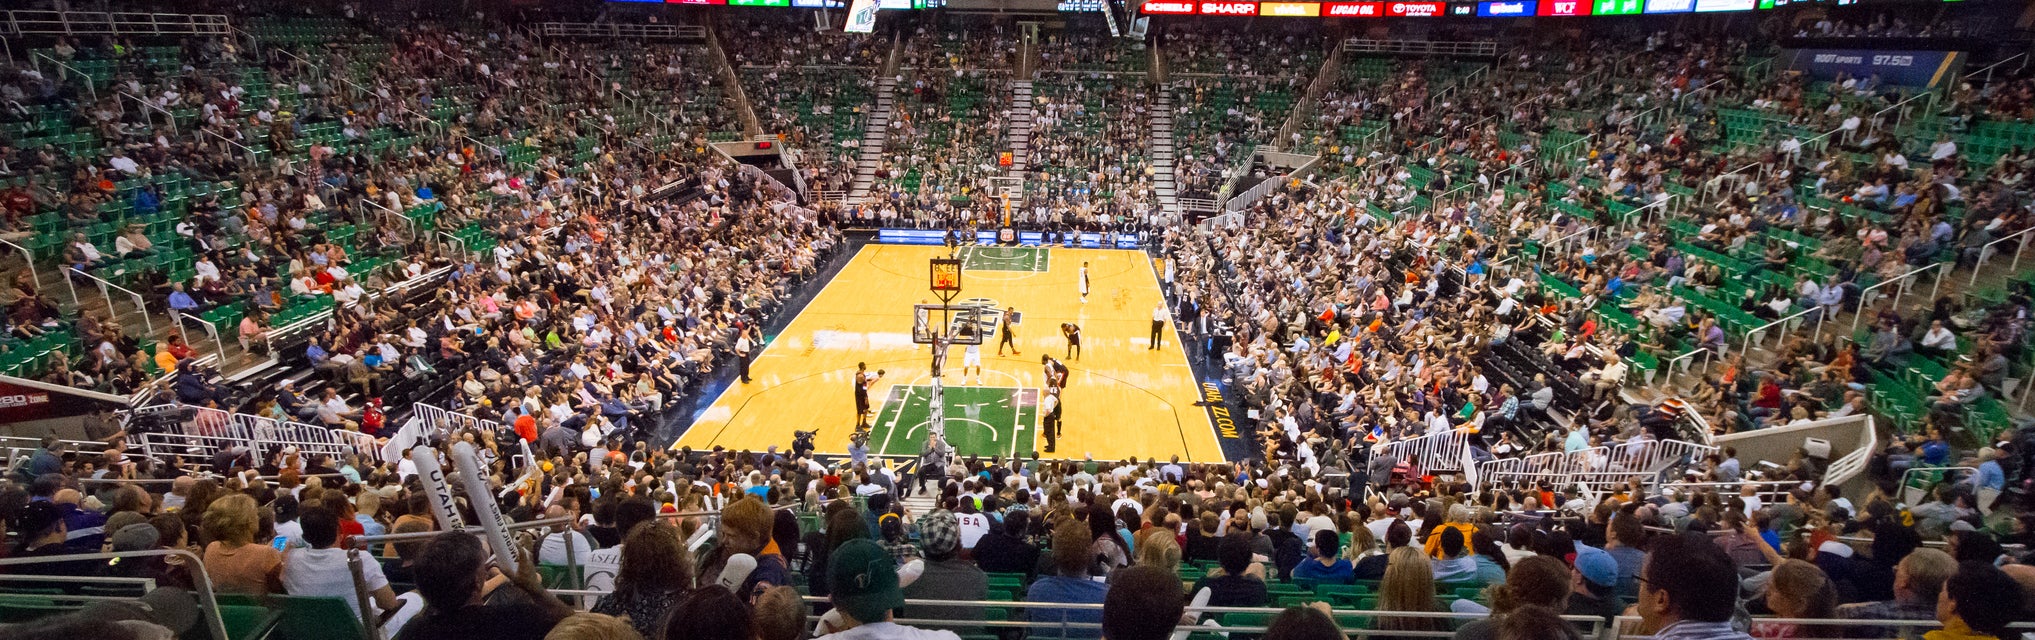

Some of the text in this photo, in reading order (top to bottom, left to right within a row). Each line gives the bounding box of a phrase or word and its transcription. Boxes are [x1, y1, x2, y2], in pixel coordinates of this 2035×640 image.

[1144, 3, 1192, 12] SCHEELS
[1201, 3, 1254, 13] SHARP
[1330, 5, 1374, 15] LUCAS OIL
[1405, 4, 1436, 12] TOYOTA
[1814, 54, 1836, 63] ROOT
[430, 469, 455, 518] UTAH
